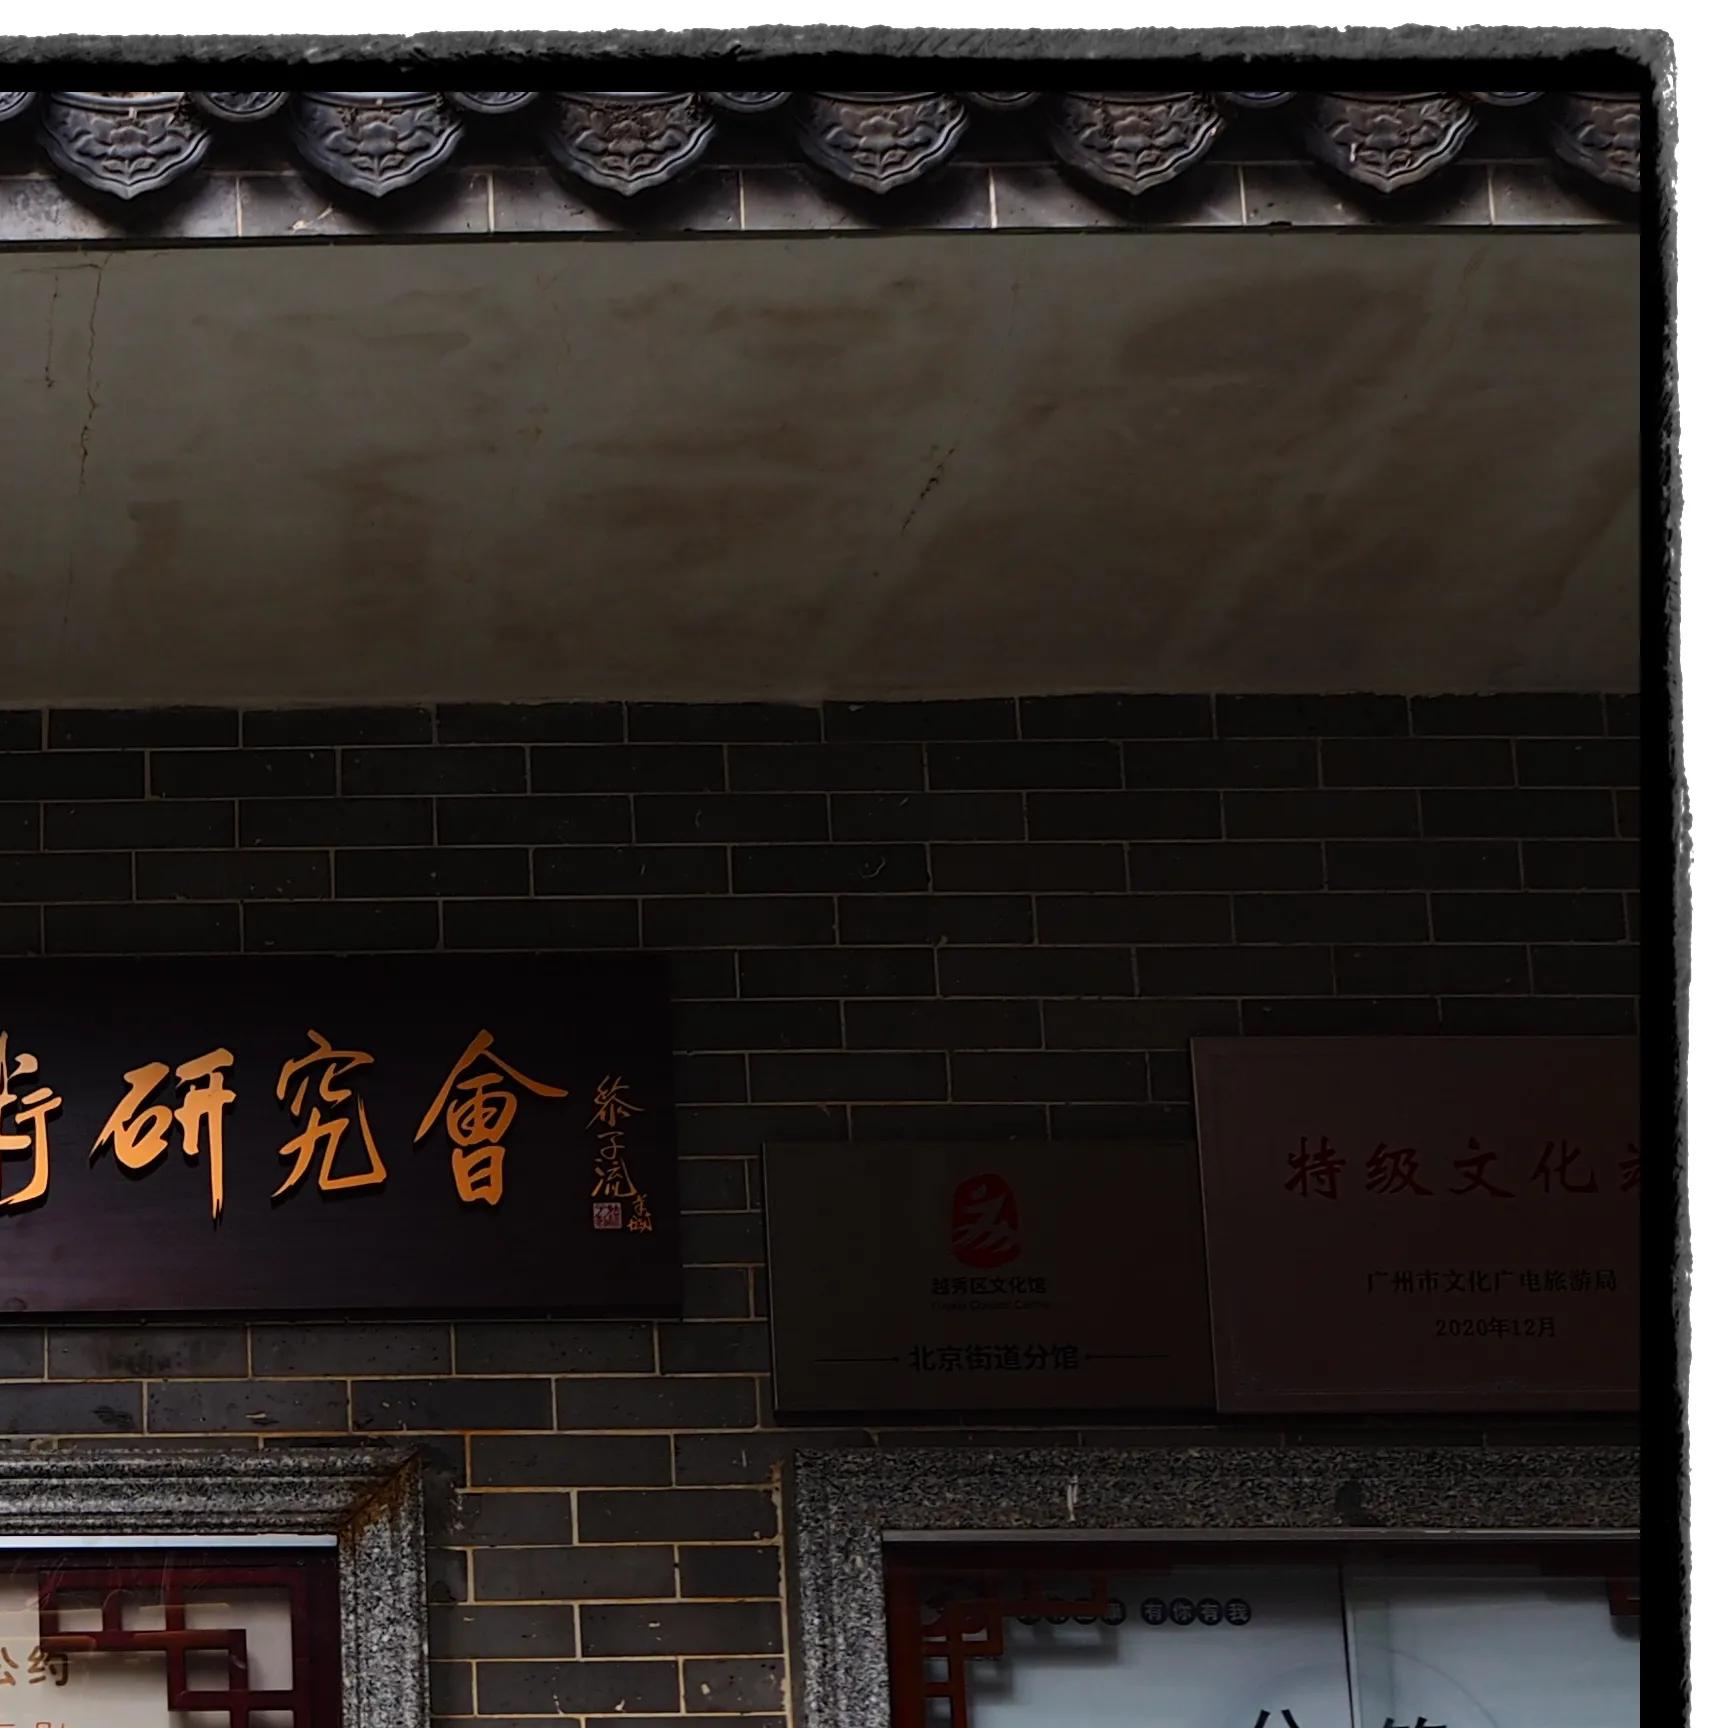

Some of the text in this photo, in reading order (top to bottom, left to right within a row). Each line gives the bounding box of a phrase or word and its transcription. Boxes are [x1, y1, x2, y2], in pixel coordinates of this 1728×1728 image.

[1366, 1266, 1618, 1295] 广州市文化广电旅游局
[1435, 1315, 1557, 1341] 2020年12月
[908, 1342, 1080, 1373] 北京街道分馆
